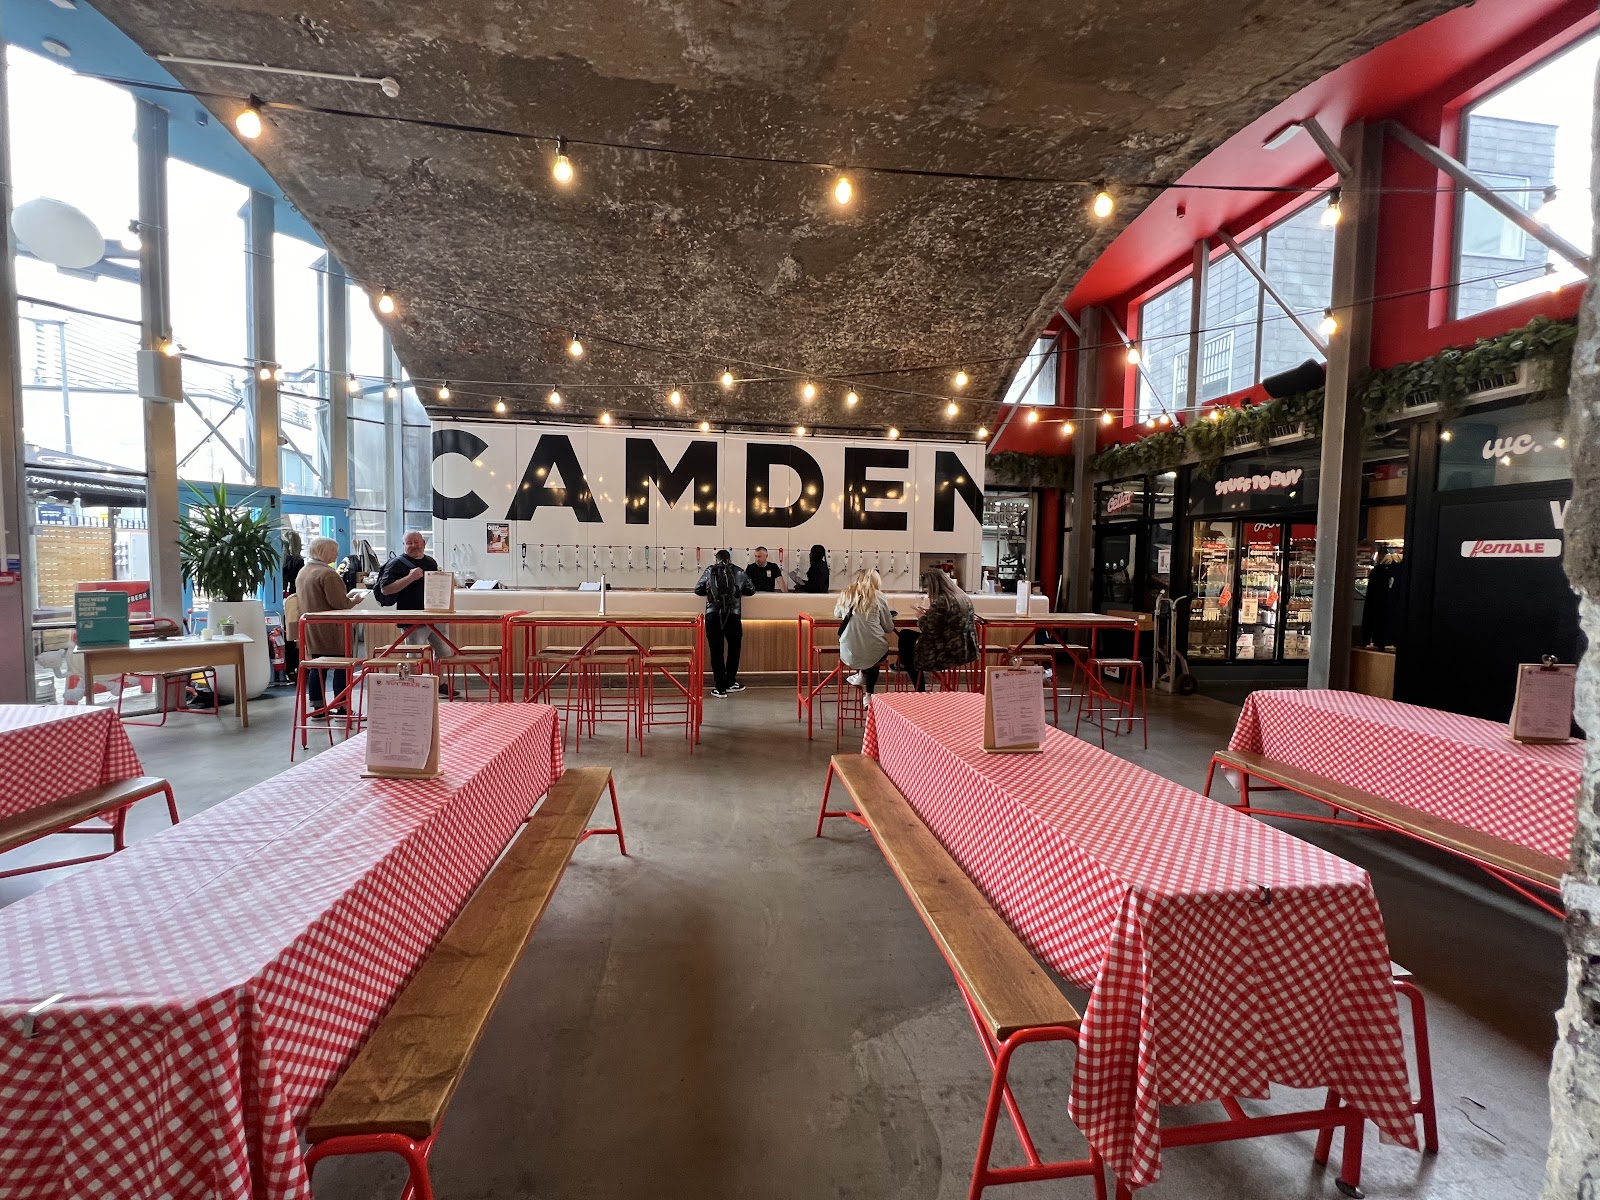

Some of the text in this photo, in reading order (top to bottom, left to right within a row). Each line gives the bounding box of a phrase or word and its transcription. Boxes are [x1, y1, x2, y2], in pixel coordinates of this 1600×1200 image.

[433, 429, 984, 532] CAMDEN
[1215, 469, 1302, 496] STUFF TO BUY
[128, 592, 148, 603] FRESH
